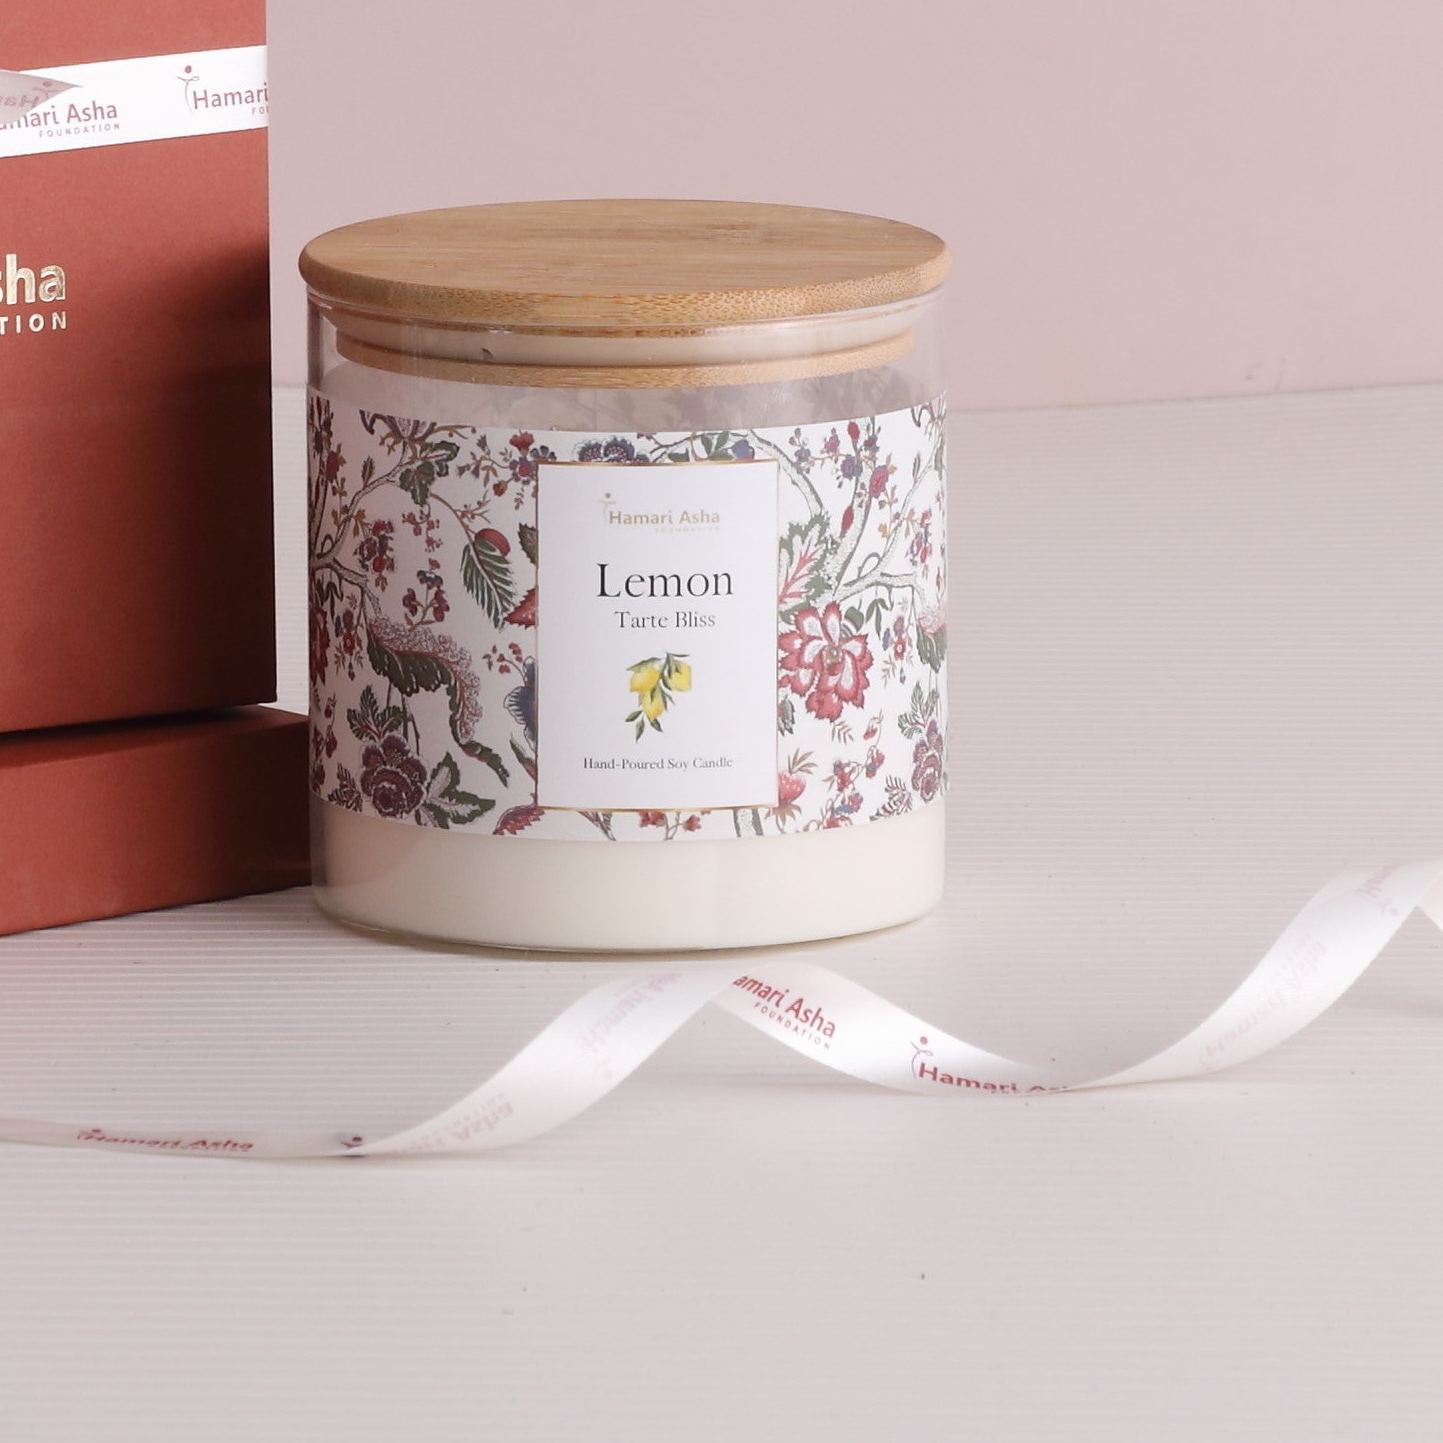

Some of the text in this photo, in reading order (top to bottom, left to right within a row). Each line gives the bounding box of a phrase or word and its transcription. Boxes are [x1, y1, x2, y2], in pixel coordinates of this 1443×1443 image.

[193, 82, 268, 110] Hamari
[66, 101, 118, 123] Asha
[39, 122, 121, 138] FOUNDATION
[609, 509, 720, 524] Hamari Asha
[597, 563, 734, 598] Lemon
[614, 610, 716, 629] Tarte Bliss
[583, 756, 733, 773] Hand-Poured Soy Candle
[733, 974, 836, 1039] amari Asha
[753, 1001, 831, 1050] FOUNDATION
[919, 1062, 1019, 1092] Hamari
